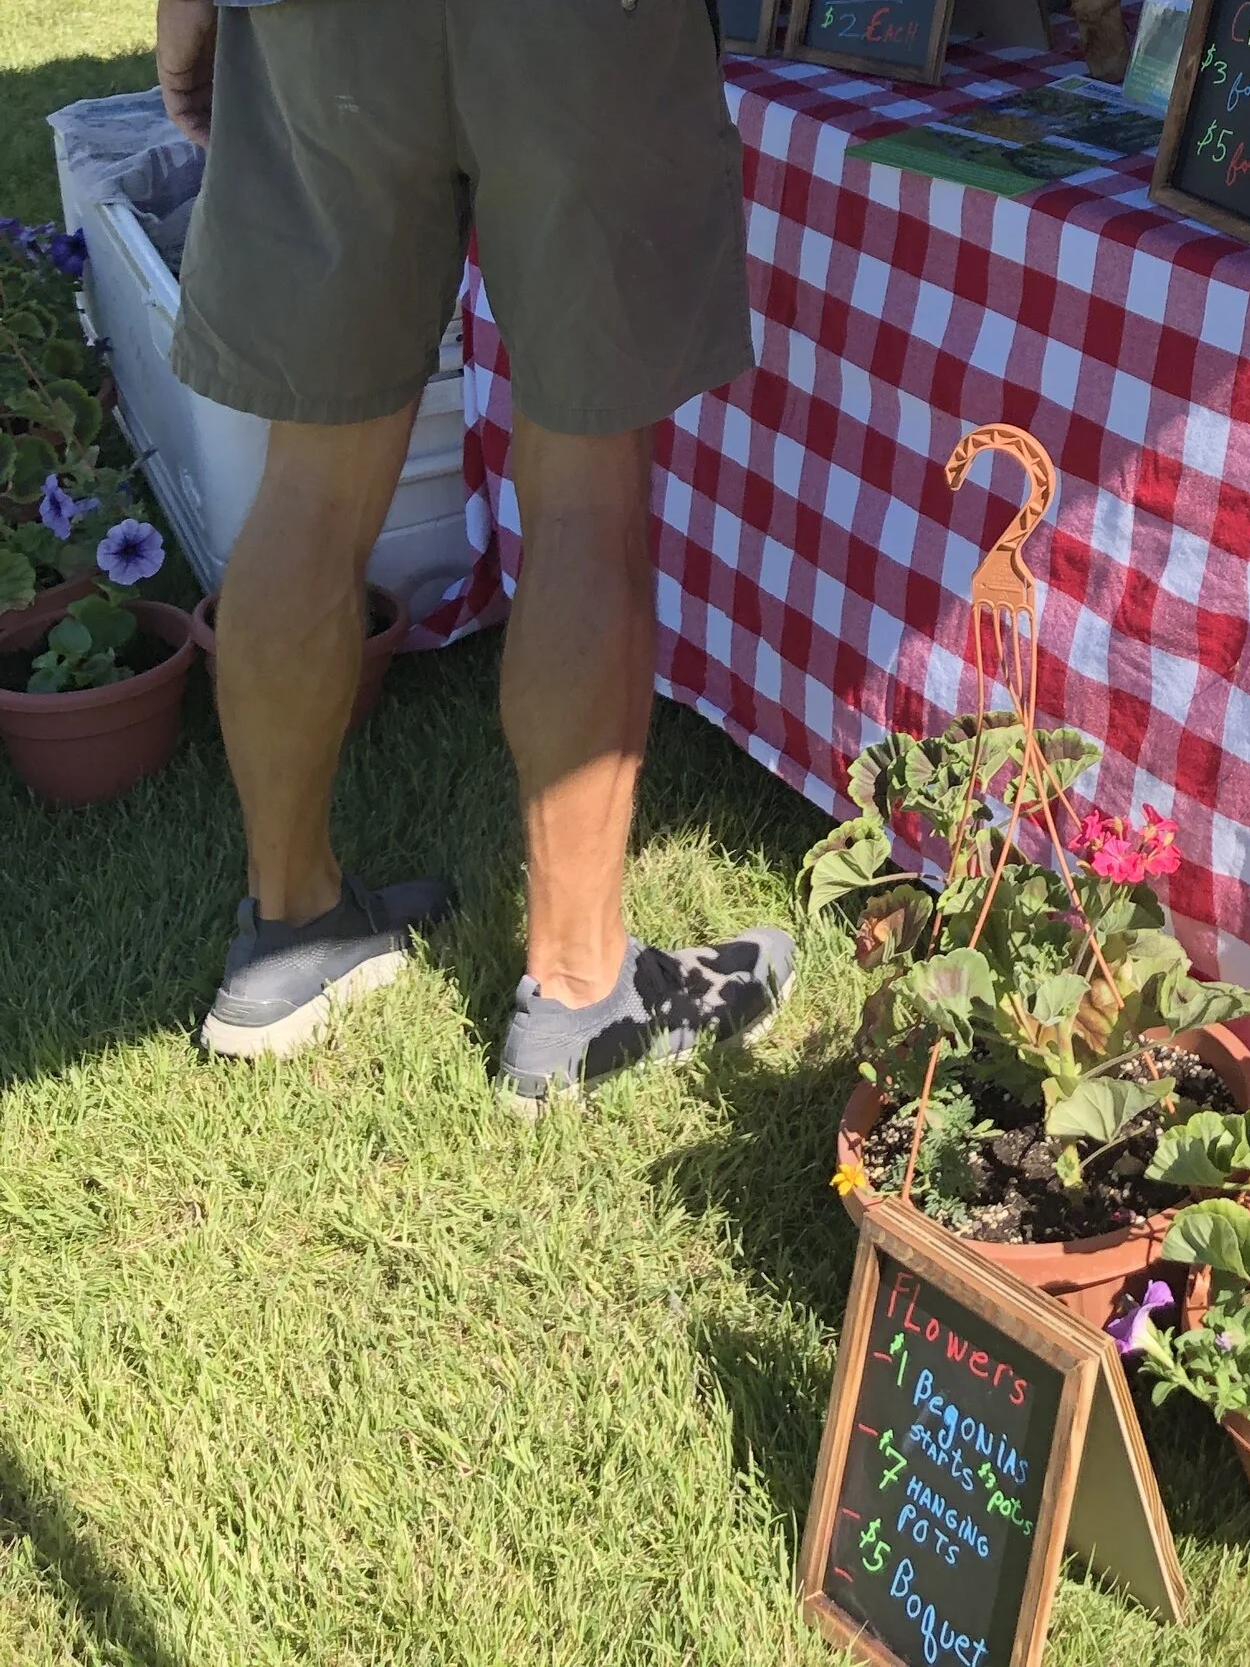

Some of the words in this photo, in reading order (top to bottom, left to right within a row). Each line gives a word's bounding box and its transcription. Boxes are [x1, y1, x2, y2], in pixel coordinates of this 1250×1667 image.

[1200, 43, 1228, 84] $3
[1197, 119, 1233, 162] $5
[859, 1518, 892, 1572] $5
